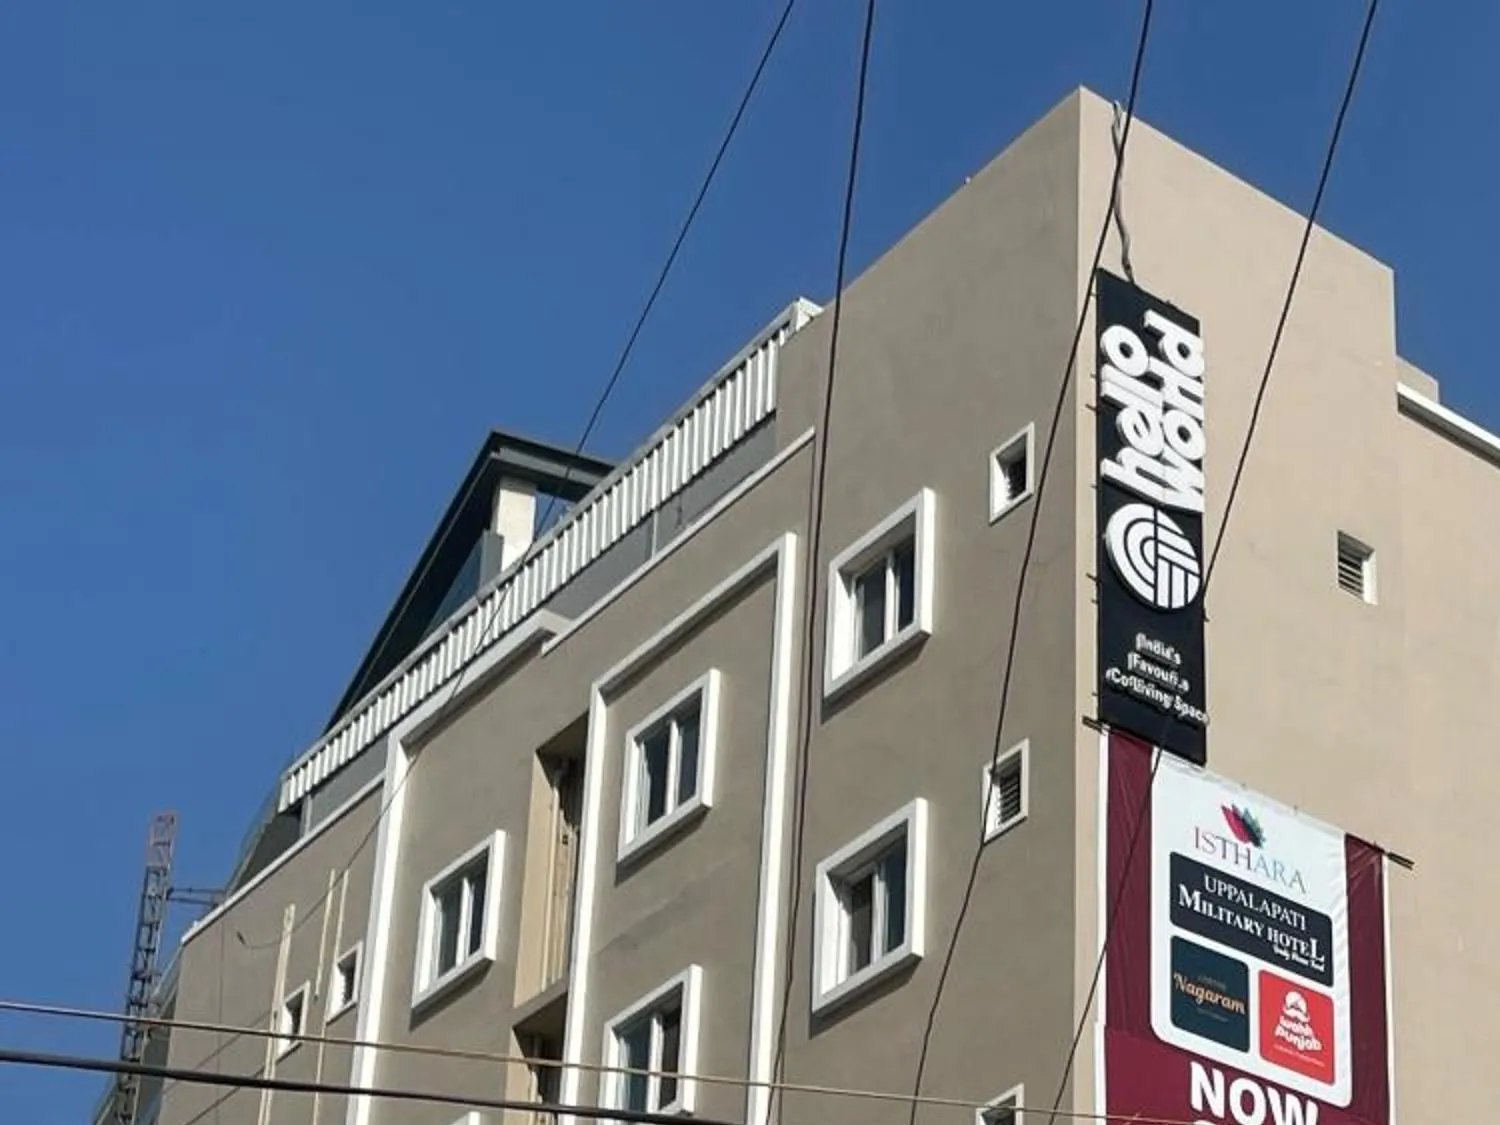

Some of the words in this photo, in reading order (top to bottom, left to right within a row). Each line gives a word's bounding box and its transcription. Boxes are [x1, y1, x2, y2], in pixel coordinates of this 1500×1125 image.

[1101, 323, 1166, 505] hello
[1194, 826, 1308, 895] ISTHARA
[1177, 883, 1265, 937] MILITARY
[1204, 873, 1307, 931] UPPALAPATI
[1174, 971, 1246, 1016] Nagaram
